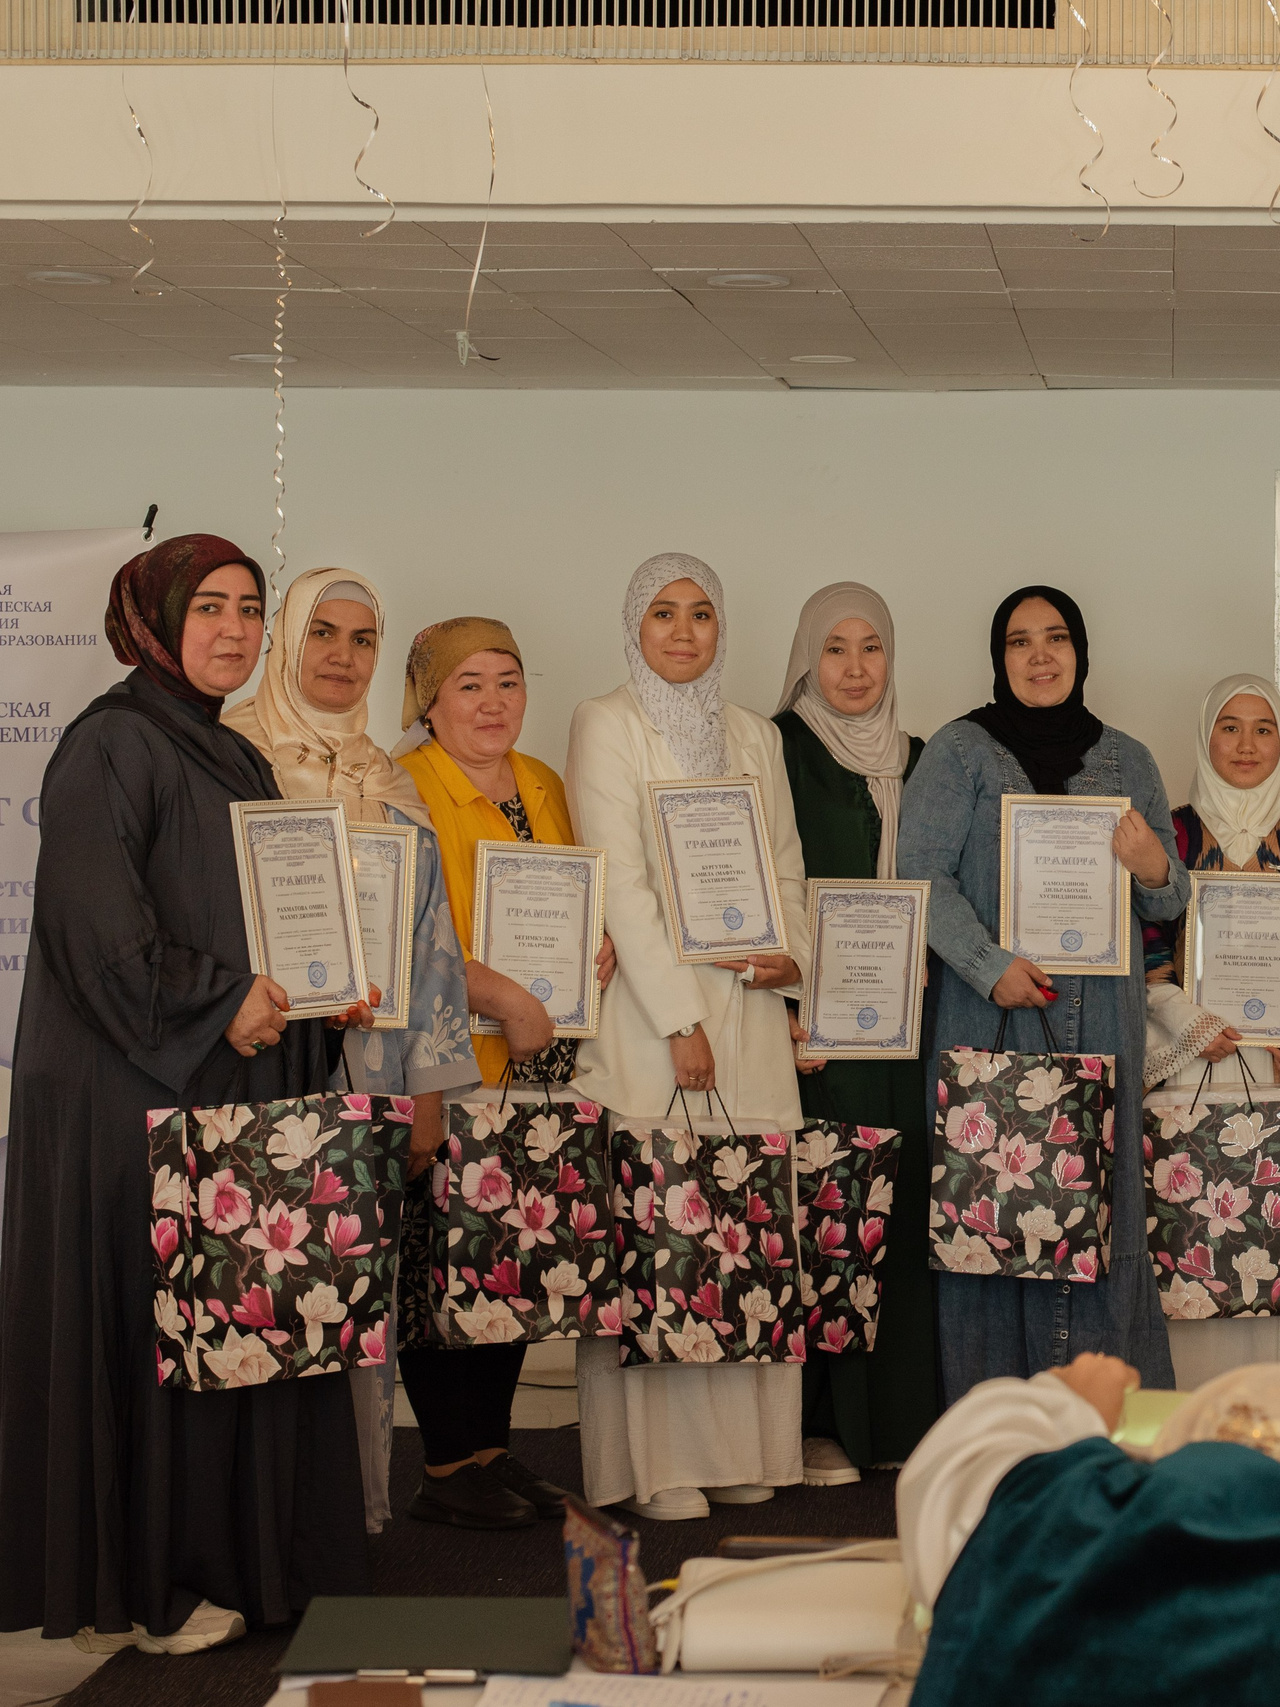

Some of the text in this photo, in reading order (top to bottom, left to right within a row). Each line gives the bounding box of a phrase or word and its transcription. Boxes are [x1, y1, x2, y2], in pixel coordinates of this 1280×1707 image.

[683, 837, 742, 849] ГРАМОТА
[1033, 855, 1098, 866] ГРАМОТА
[270, 872, 326, 887] ГРАМОТА
[505, 907, 570, 920] ГРАМОТА
[1217, 929, 1279, 941] ГРАМОТА
[834, 940, 895, 950] ГРАМОТА
